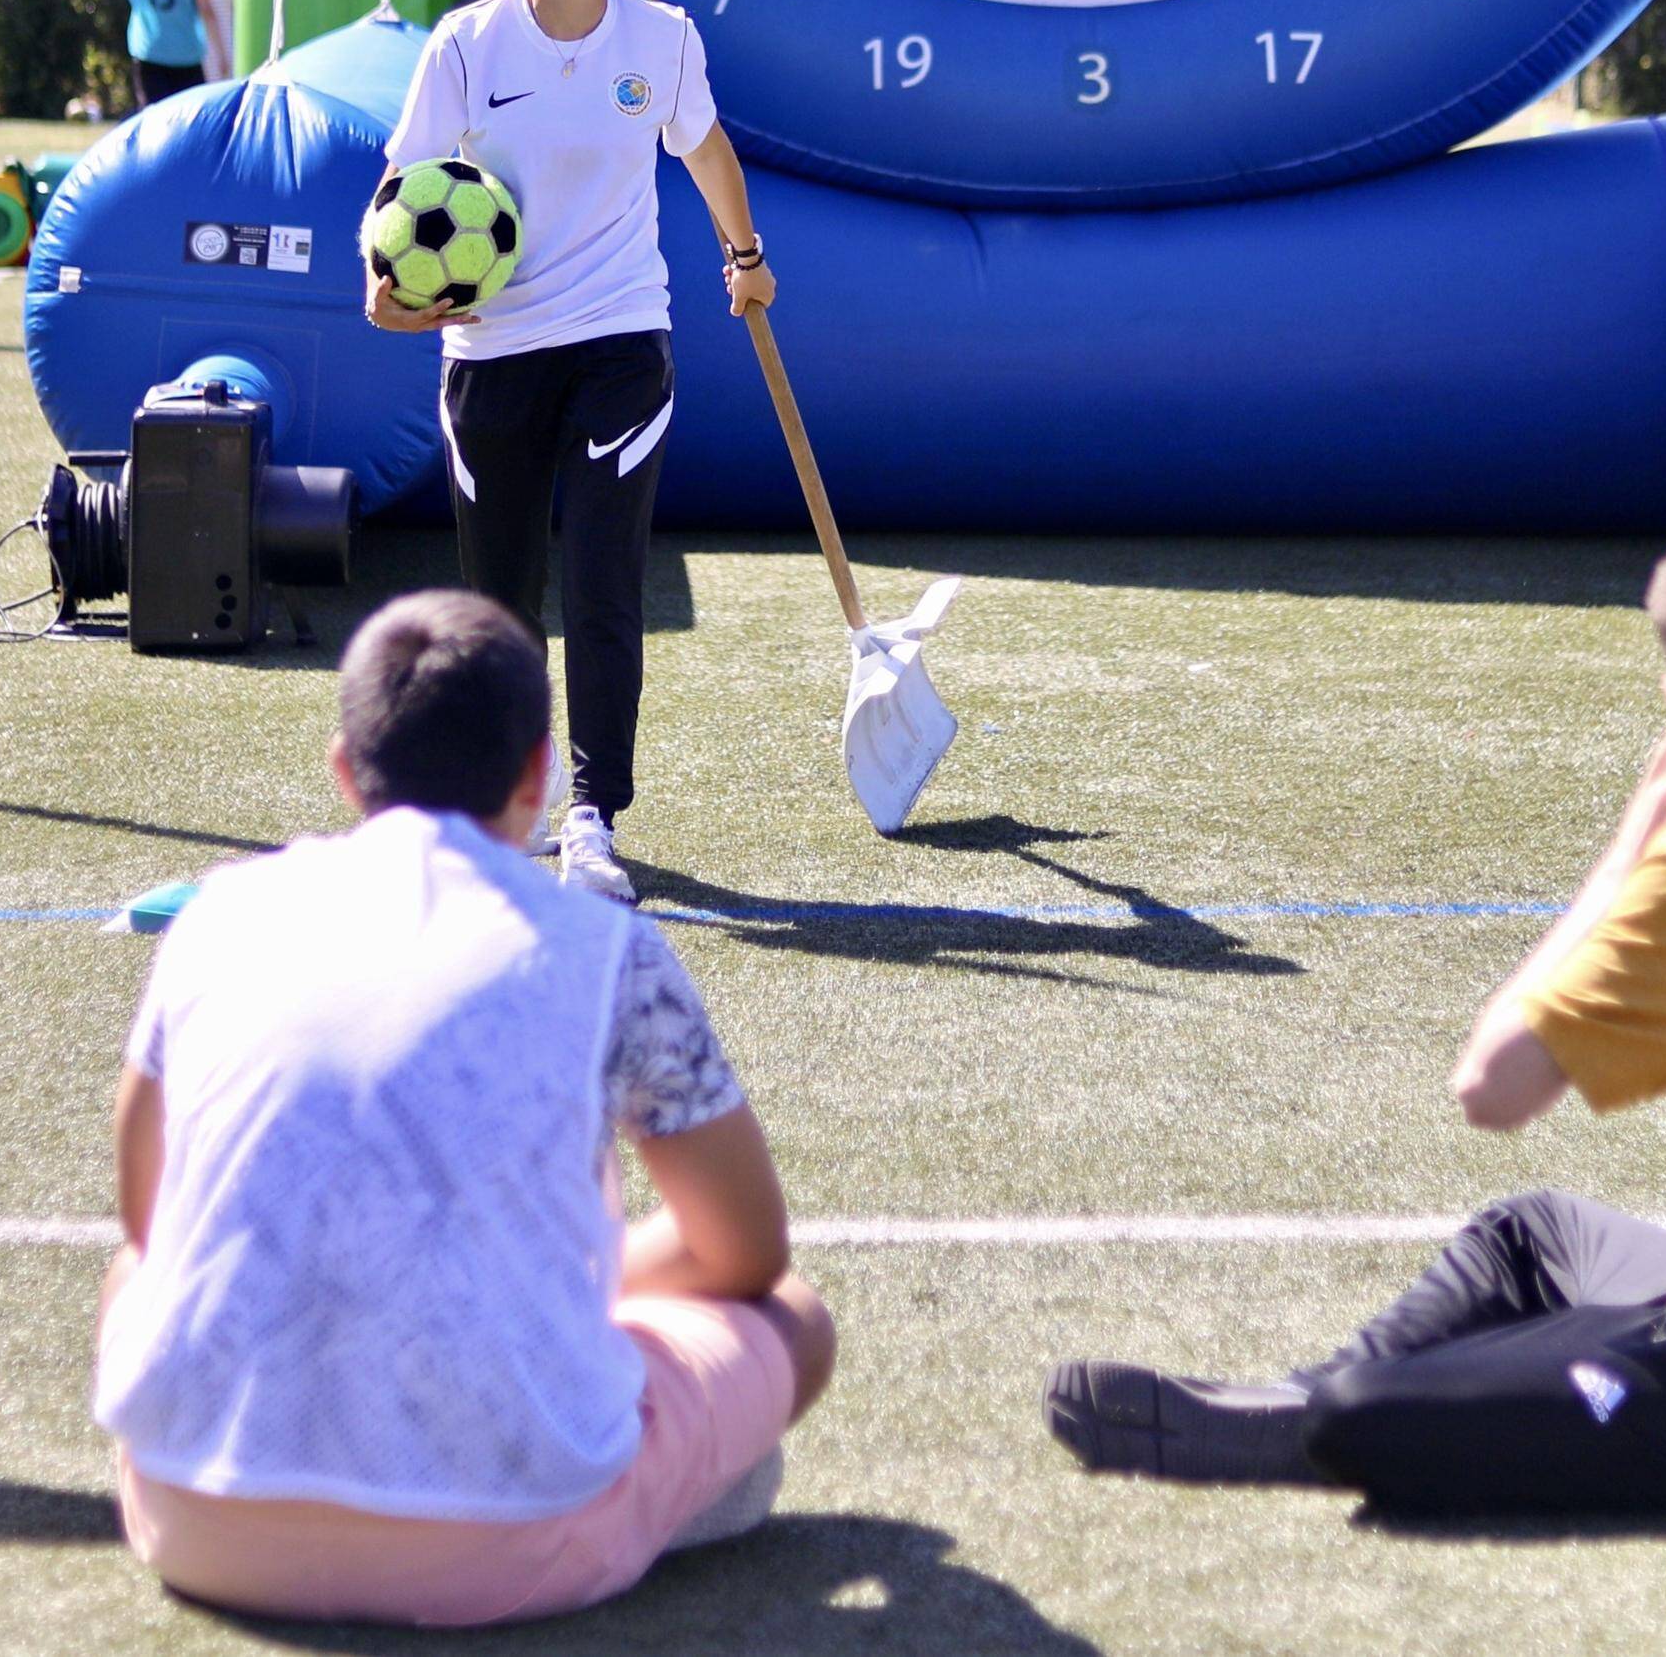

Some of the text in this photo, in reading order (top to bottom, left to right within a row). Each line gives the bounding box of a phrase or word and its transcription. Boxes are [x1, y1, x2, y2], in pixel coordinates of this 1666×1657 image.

[864, 35, 932, 90] 19
[1078, 53, 1110, 104] 3
[1255, 32, 1323, 84] 17
